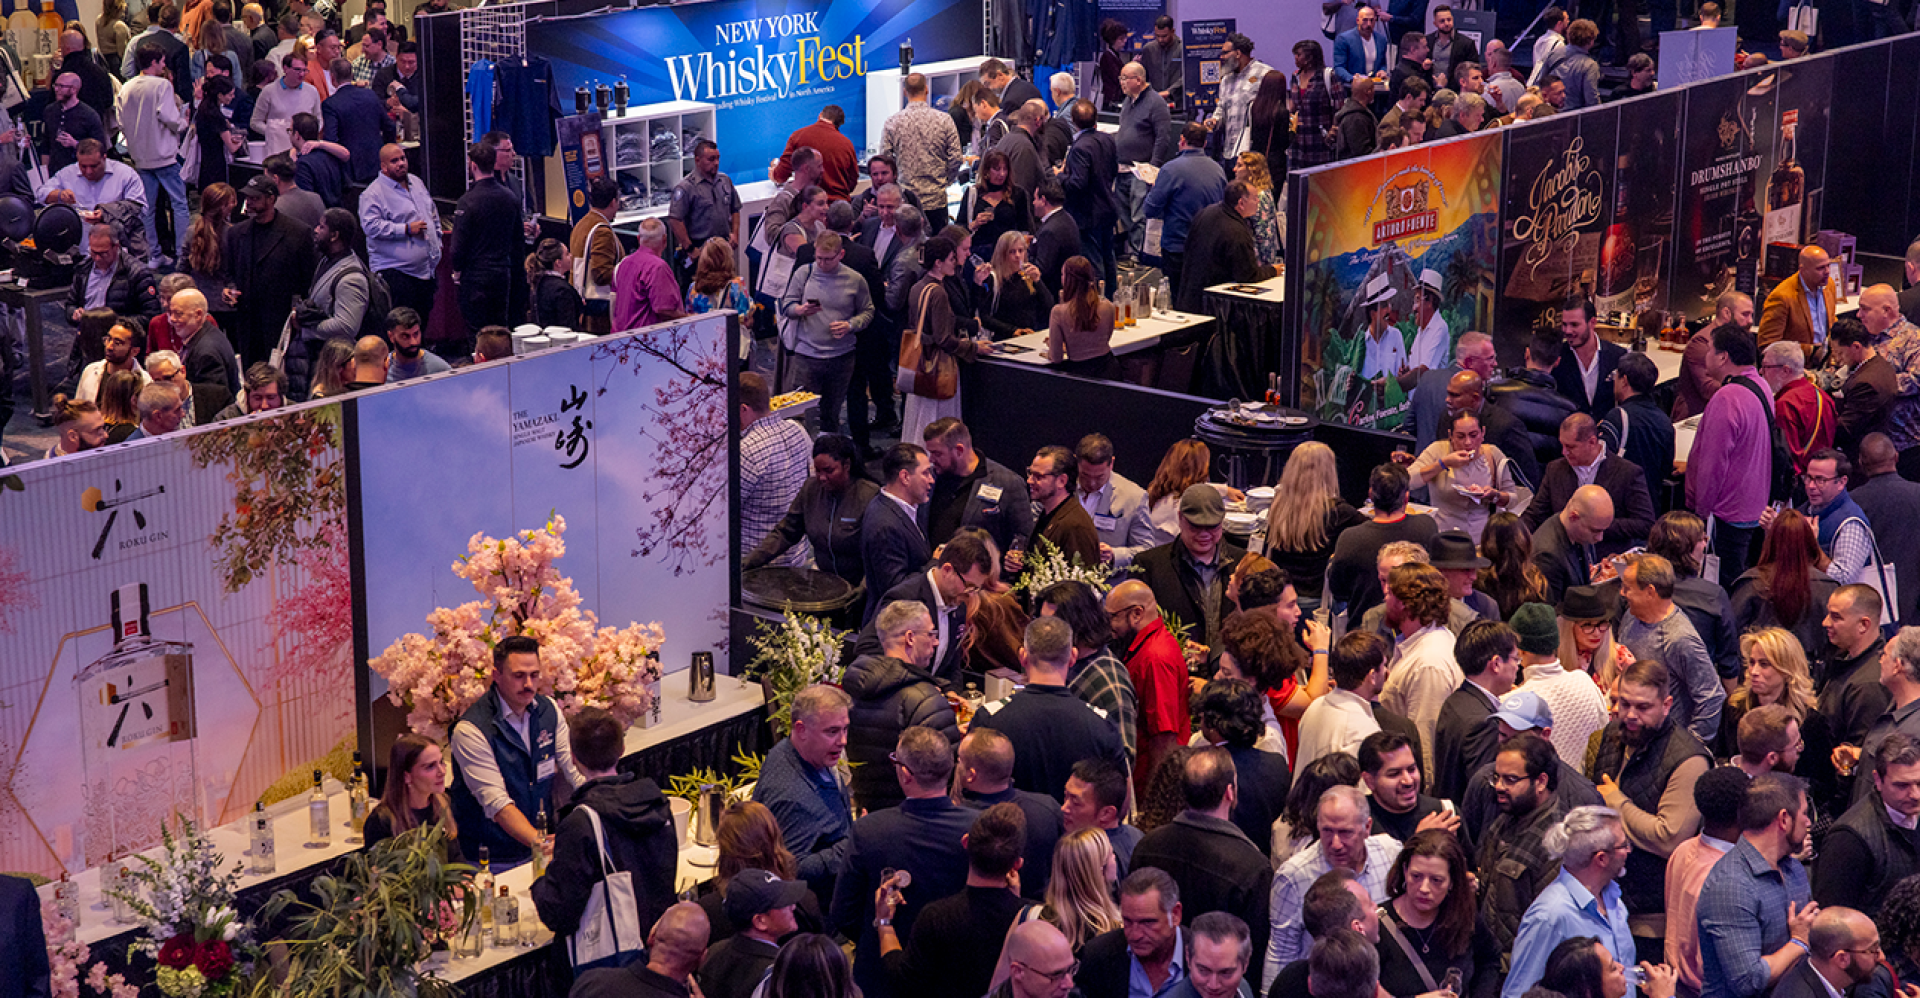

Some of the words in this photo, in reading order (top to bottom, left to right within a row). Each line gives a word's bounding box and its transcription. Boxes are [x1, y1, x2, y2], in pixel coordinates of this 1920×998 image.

[715, 18, 762, 46] NEW
[765, 11, 819, 39] YORK
[664, 35, 867, 101] WhiskyFest
[716, 100, 734, 110] ading
[734, 96, 755, 107] Whisky
[755, 91, 777, 104] Festival
[796, 87, 814, 97] North
[813, 86, 836, 96] America
[1690, 154, 1761, 187] DRUMSHANBO
[1376, 219, 1406, 240] ARTURO
[1406, 213, 1436, 232] FUENTE
[513, 410, 528, 420] THE
[513, 412, 559, 433] YAMAZAKI
[554, 384, 593, 469] 山崎
[118, 537, 147, 551] ROKU
[149, 530, 169, 544] GIN
[121, 730, 145, 743] ROKU
[146, 724, 163, 737] GIN
